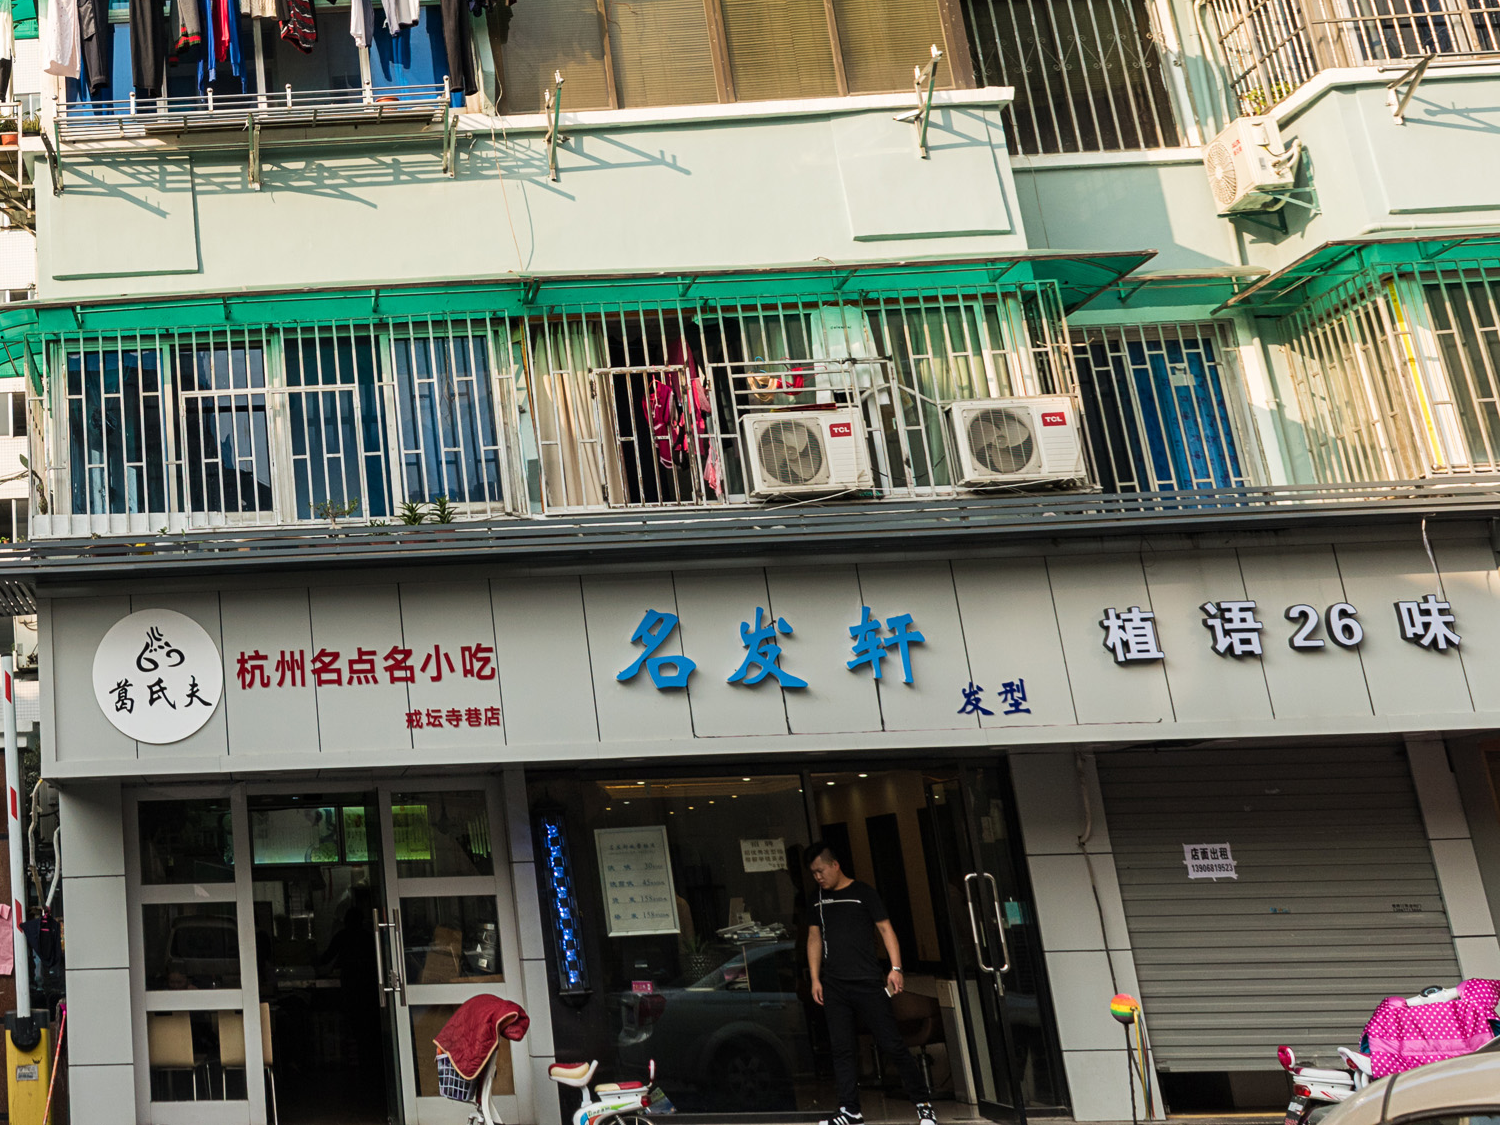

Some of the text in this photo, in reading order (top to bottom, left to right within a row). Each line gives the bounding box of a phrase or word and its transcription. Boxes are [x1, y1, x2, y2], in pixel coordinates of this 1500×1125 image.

[616, 605, 926, 690] 名发轩
[1100, 593, 1462, 665] 植语26味
[236, 643, 496, 690] 杭州名点名小吃
[108, 674, 213, 715] 葛氏夫
[957, 678, 1031, 716] 发型
[405, 707, 501, 729] 戒坛寺巷店
[1191, 847, 1229, 861] 店面出租
[1191, 863, 1234, 874] 13906819523
